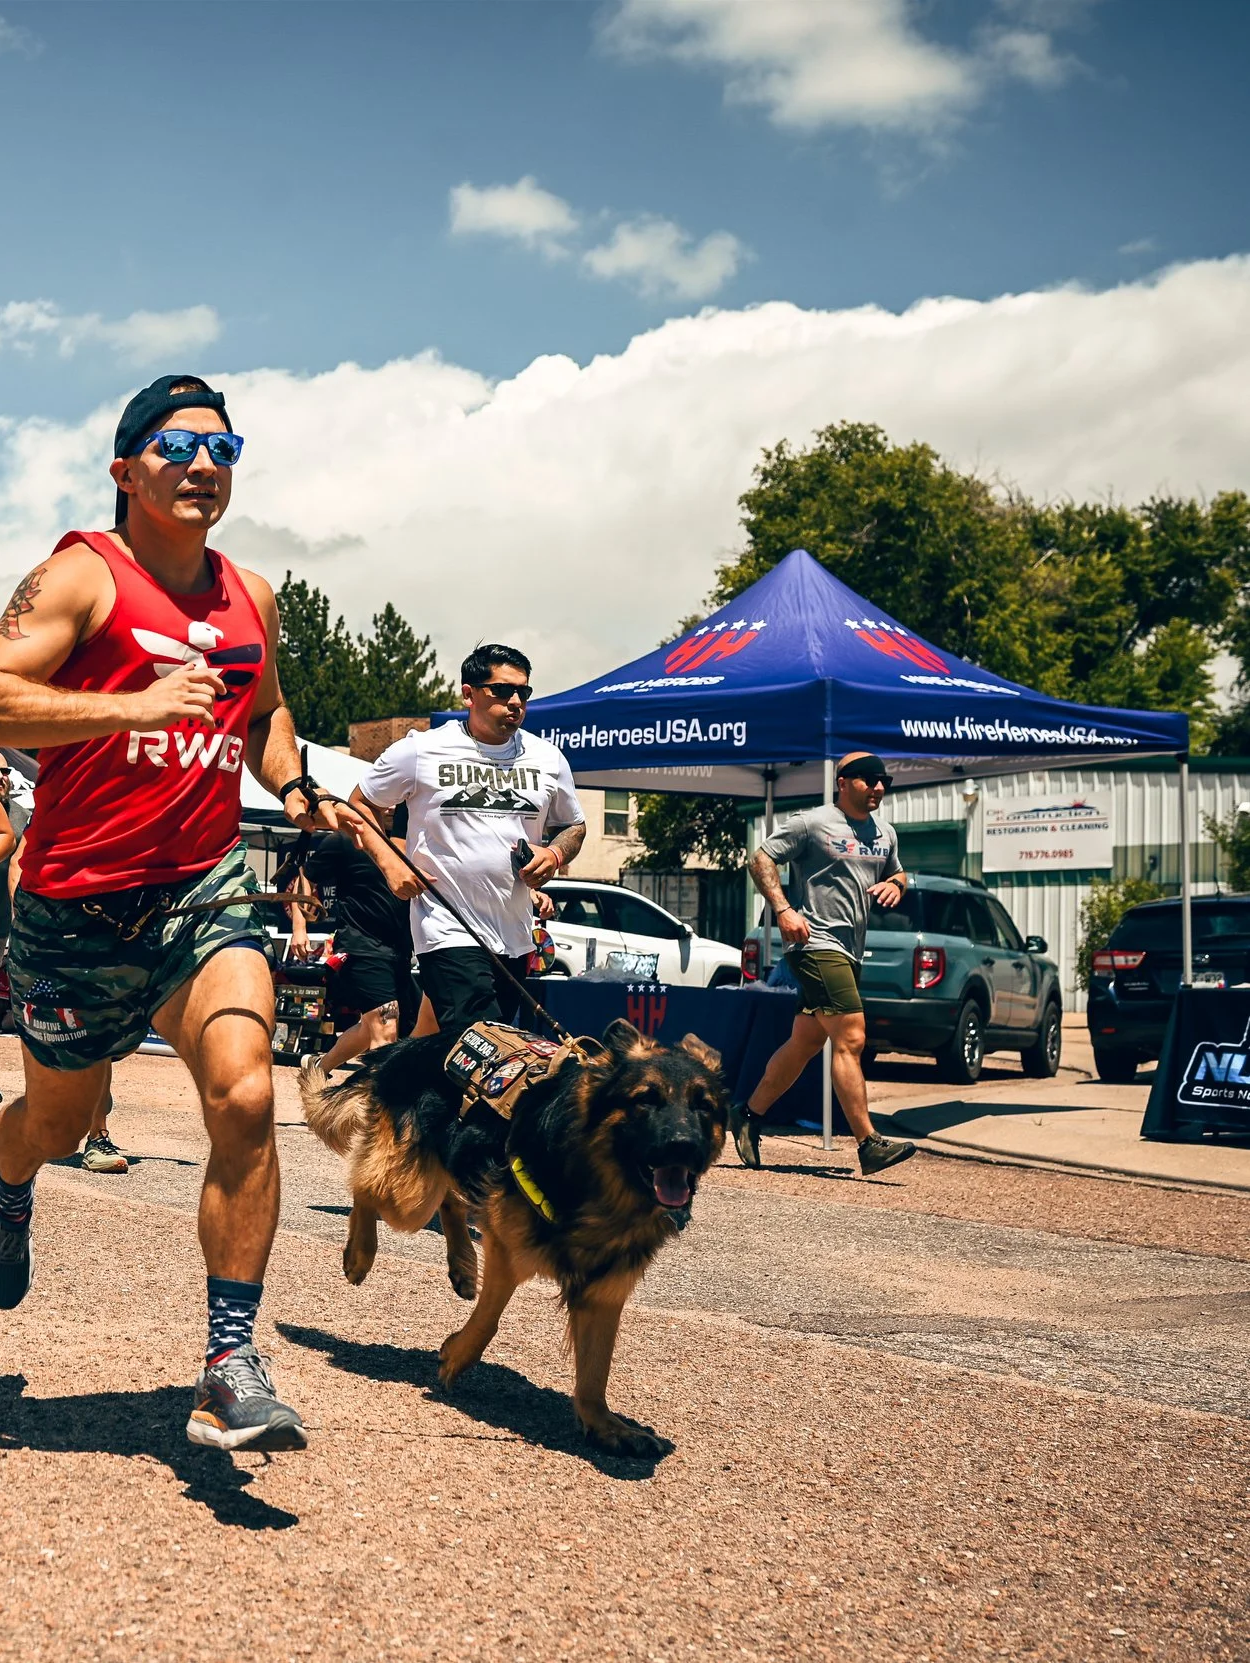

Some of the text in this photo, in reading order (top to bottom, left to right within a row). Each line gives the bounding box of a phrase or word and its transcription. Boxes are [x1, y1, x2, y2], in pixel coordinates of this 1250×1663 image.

[126, 730, 244, 774] RWB
[438, 763, 541, 792] SUMMIT
[986, 822, 1110, 836] RESTORATION & CLEANING
[859, 847, 890, 857] RWB
[33, 1018, 62, 1032] ADAPTIVE
[43, 1028, 88, 1042] FOUNDATION
[463, 1031, 495, 1058] GUIDE DOG
[1191, 1085, 1236, 1099] Sports
